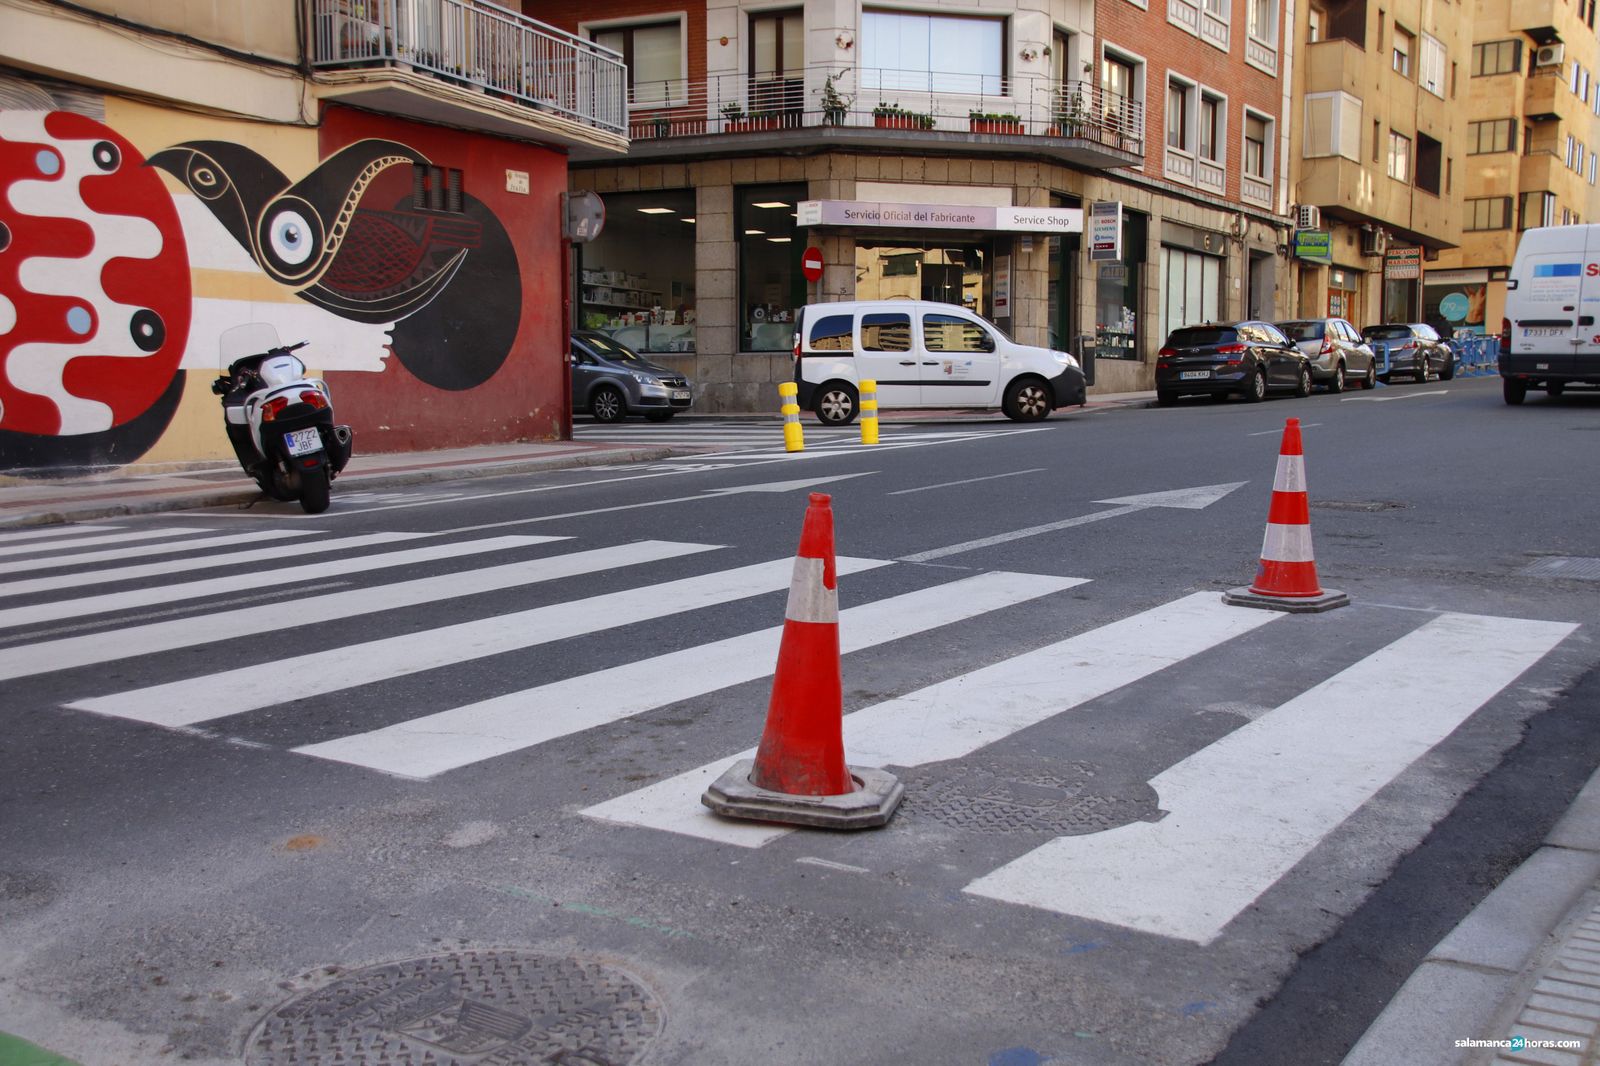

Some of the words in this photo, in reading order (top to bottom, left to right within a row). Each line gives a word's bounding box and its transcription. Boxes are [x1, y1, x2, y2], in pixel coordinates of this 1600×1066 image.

[844, 209, 881, 220] Servicio
[883, 210, 912, 222] Oficial
[914, 211, 928, 221] del
[930, 212, 976, 224] Fabricante
[1013, 214, 1045, 226] Service
[1047, 215, 1070, 229] Shop
[292, 429, 318, 443] 2722
[297, 440, 313, 452] JBF
